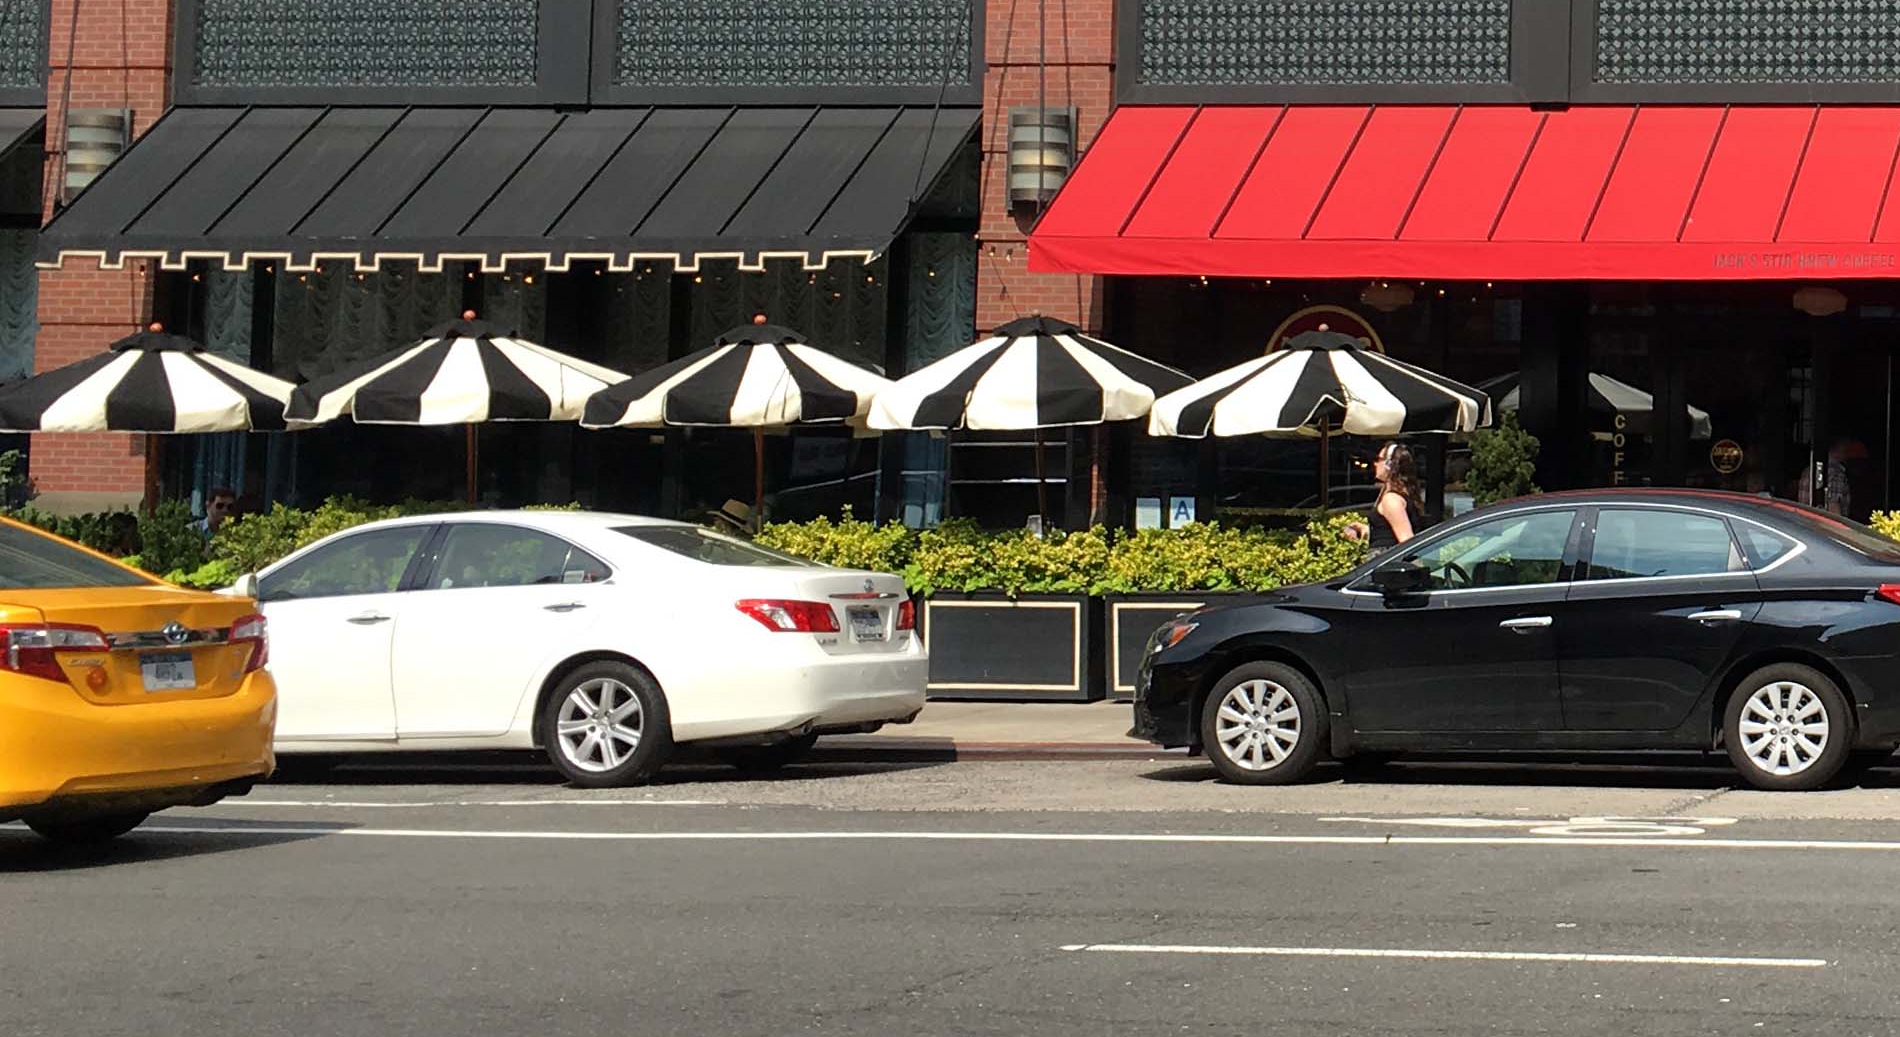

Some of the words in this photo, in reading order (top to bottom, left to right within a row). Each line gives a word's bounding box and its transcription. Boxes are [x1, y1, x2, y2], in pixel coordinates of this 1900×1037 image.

[1714, 254, 1757, 269] JACK'S
[1762, 254, 1793, 269] STIR
[1797, 254, 1838, 269] BREW
[1843, 254, 1895, 268] COFFEE
[1614, 414, 1626, 485] COFF
[1174, 499, 1191, 520] A
